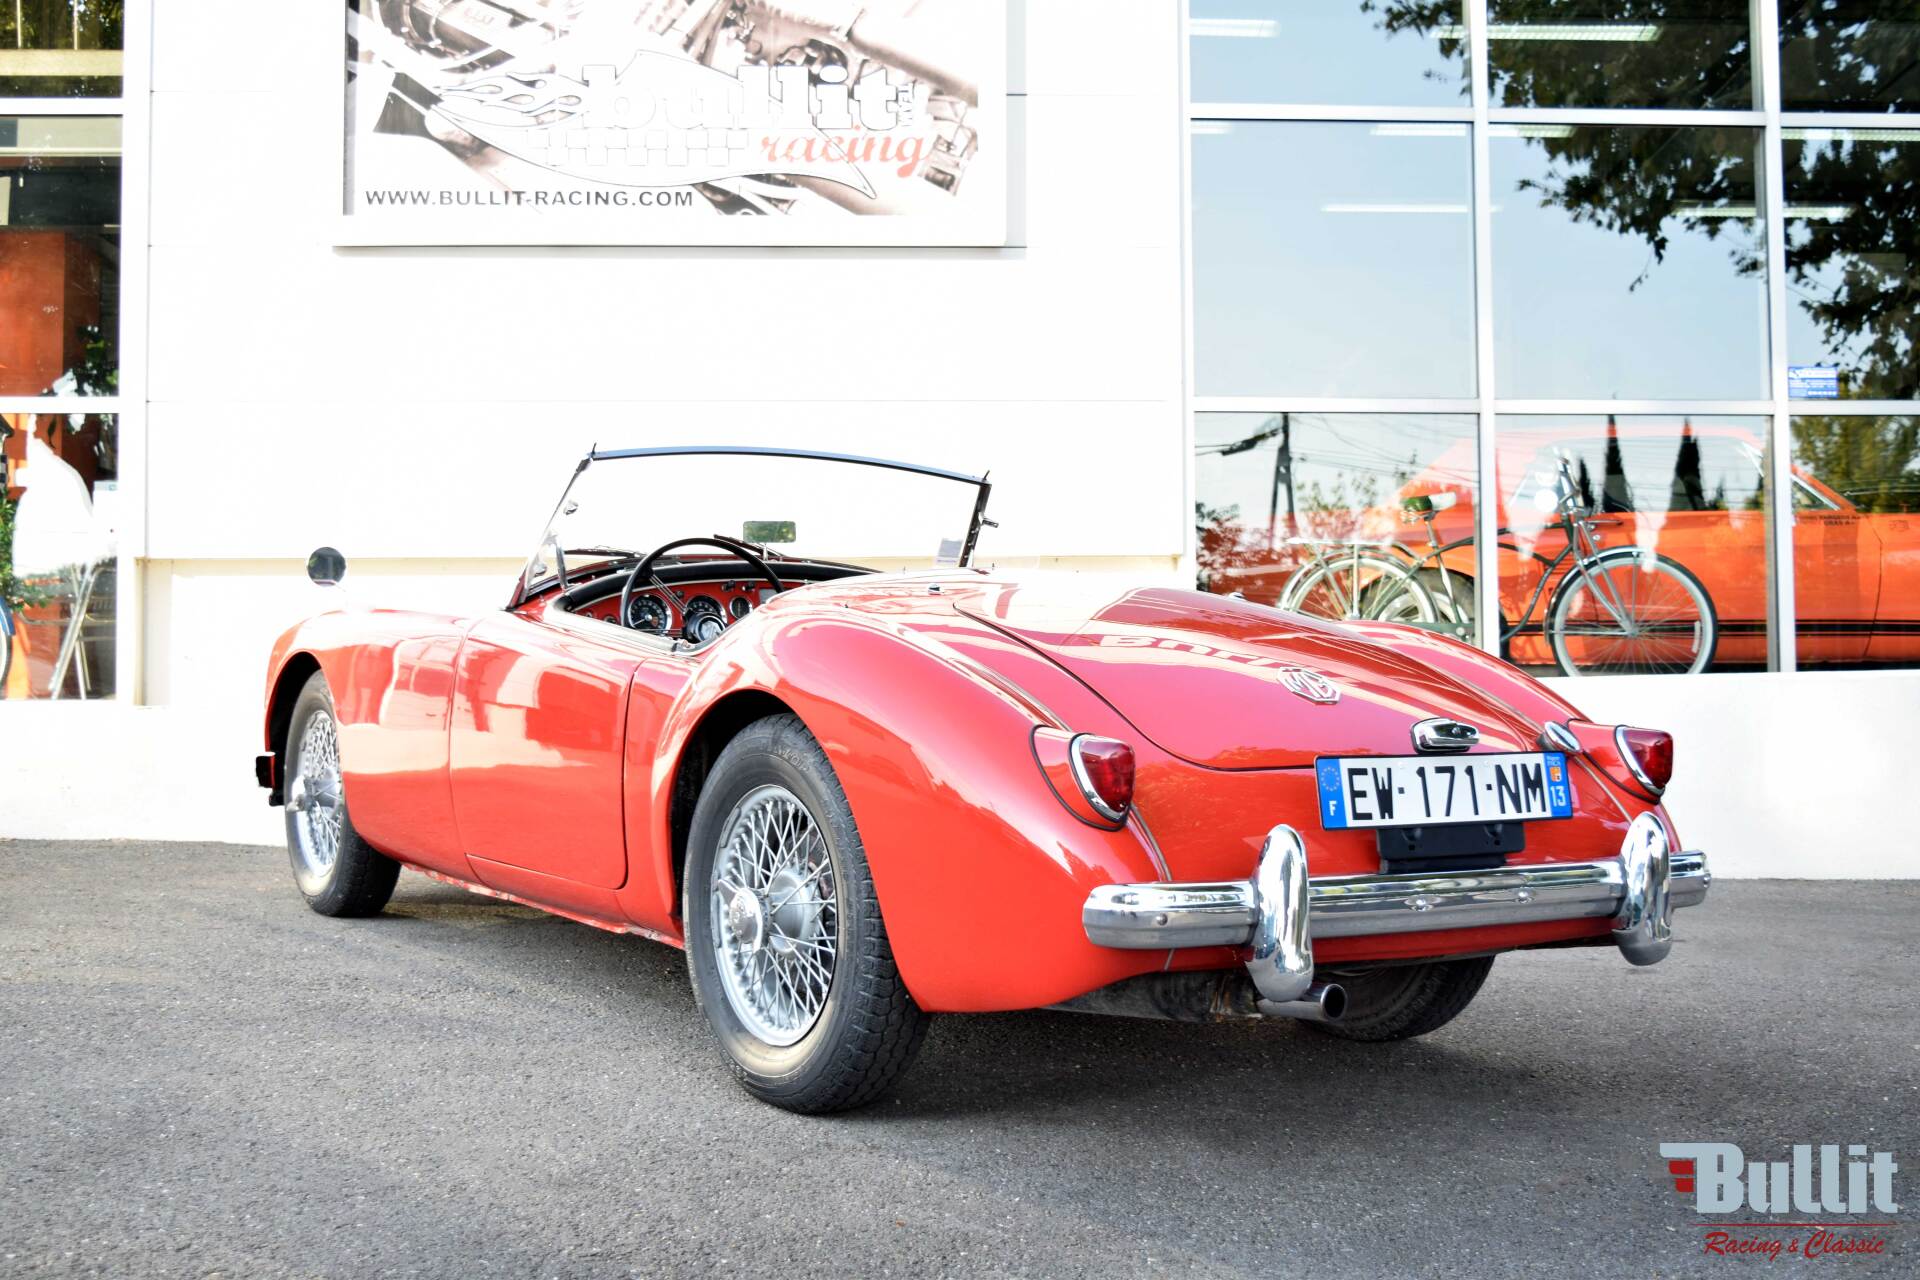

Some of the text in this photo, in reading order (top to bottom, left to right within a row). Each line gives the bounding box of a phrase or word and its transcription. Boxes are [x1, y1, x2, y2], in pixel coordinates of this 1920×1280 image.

[582, 64, 898, 131] bullit
[761, 124, 928, 178] racing
[365, 190, 693, 206] WWW.BULLIT-RACING.COM
[1283, 668, 1338, 699] MG
[1328, 800, 1338, 816] F
[1550, 785, 1567, 807] 13
